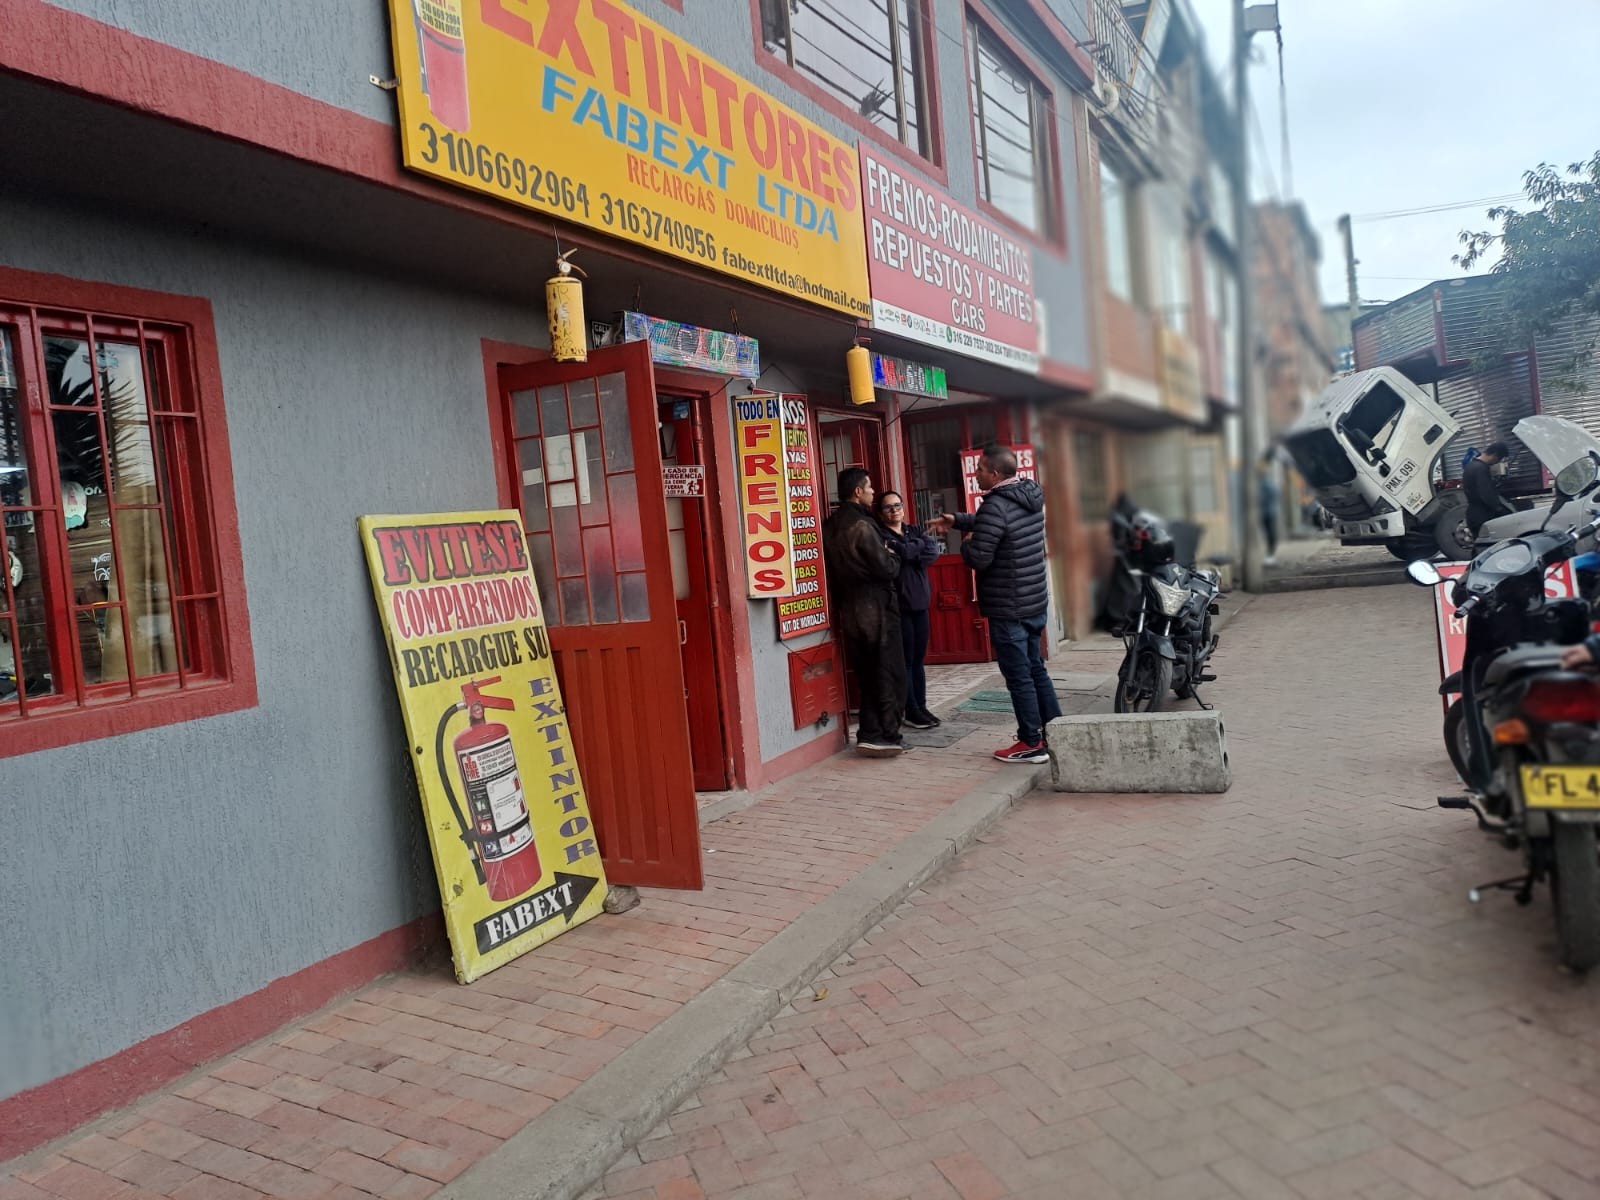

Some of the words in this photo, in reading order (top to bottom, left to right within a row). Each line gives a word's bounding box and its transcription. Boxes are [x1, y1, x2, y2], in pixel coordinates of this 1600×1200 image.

[541, 64, 735, 191] FABEXT
[756, 173, 839, 242] LTDA
[419, 122, 590, 218] 3106692964
[600, 192, 717, 262] 3163740956
[722, 247, 872, 315] fabextltda@hotmail.com
[626, 152, 716, 215] RECARGAS
[724, 198, 799, 249] DOMICILIOS
[871, 218, 972, 299] REPUESTOS
[975, 269, 985, 303] Y
[987, 275, 1033, 323] PARTES
[951, 297, 986, 333] CARS
[736, 401, 763, 421] TODO
[766, 399, 780, 420] EN
[783, 400, 805, 426] NOS
[743, 422, 786, 592] FRENOS
[790, 501, 810, 513] COS
[791, 516, 816, 529] UERAS
[372, 519, 528, 586] EVITESE
[792, 532, 818, 546] RUIDOS
[392, 575, 538, 640] COMPARENDOS
[780, 596, 824, 616] RETENEDORES
[796, 580, 819, 595] UIDOS
[401, 629, 522, 688] RECARGUE
[523, 626, 549, 661] SU
[528, 677, 598, 865] EXTINTOR
[485, 882, 574, 947] FABEXT
